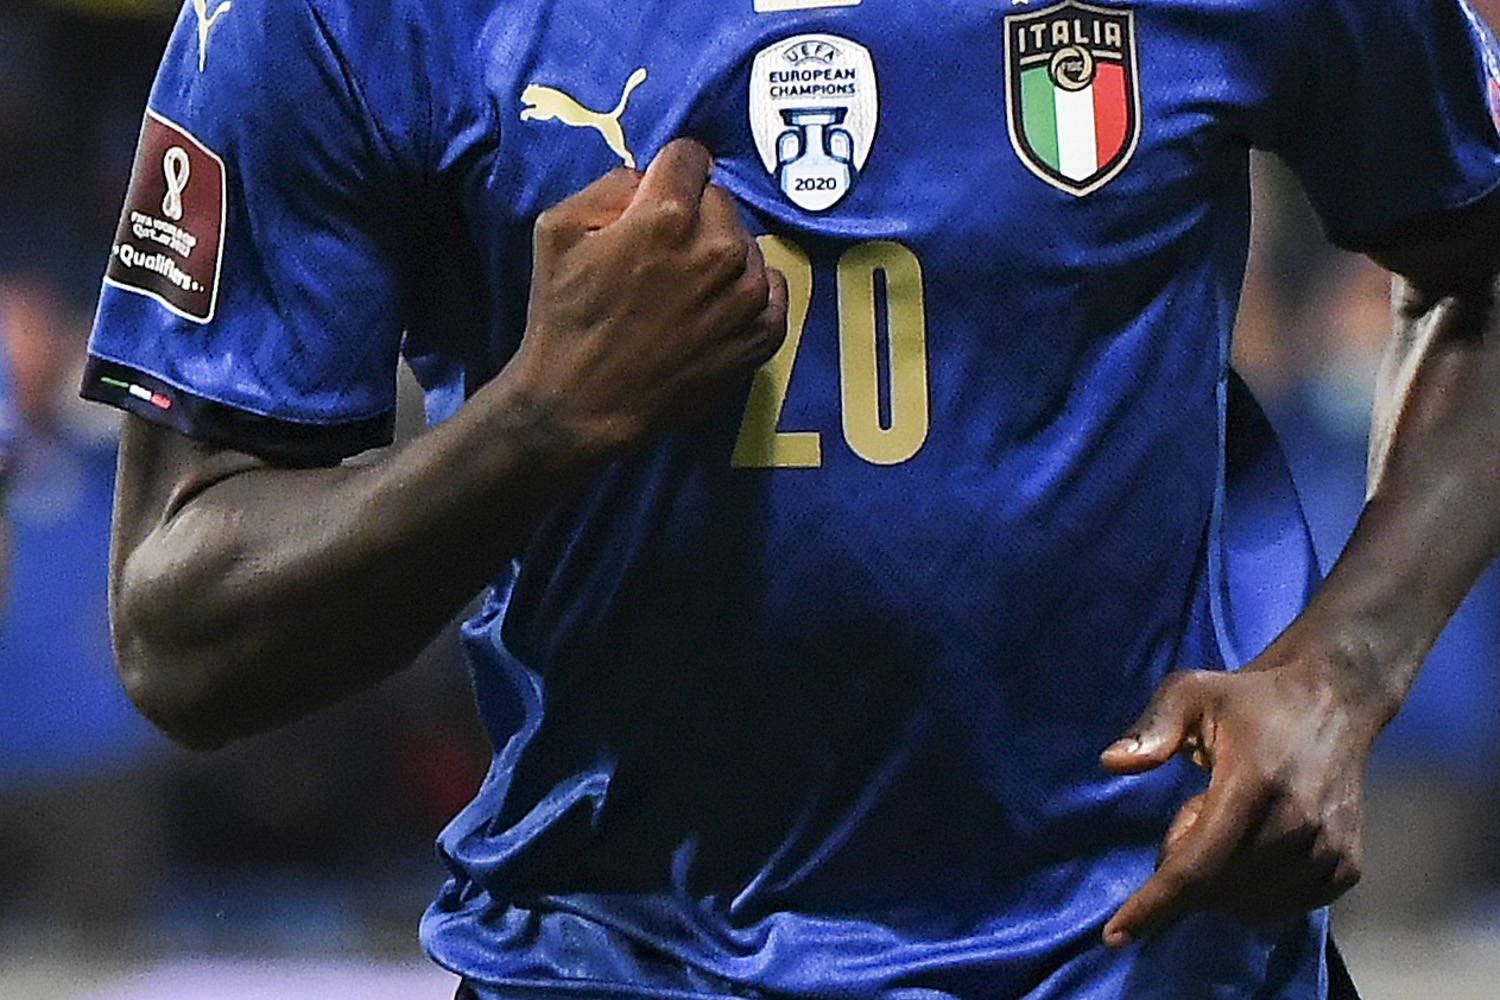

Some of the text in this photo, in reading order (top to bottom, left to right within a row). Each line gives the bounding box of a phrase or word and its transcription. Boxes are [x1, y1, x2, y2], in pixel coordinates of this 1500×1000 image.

[1018, 19, 1122, 53] ITALIA
[787, 43, 834, 62] UEFA
[769, 68, 856, 83] EUROPEAN
[769, 83, 856, 97] CHAMPIONS
[795, 177, 837, 191] 2020
[731, 234, 929, 467] 20
